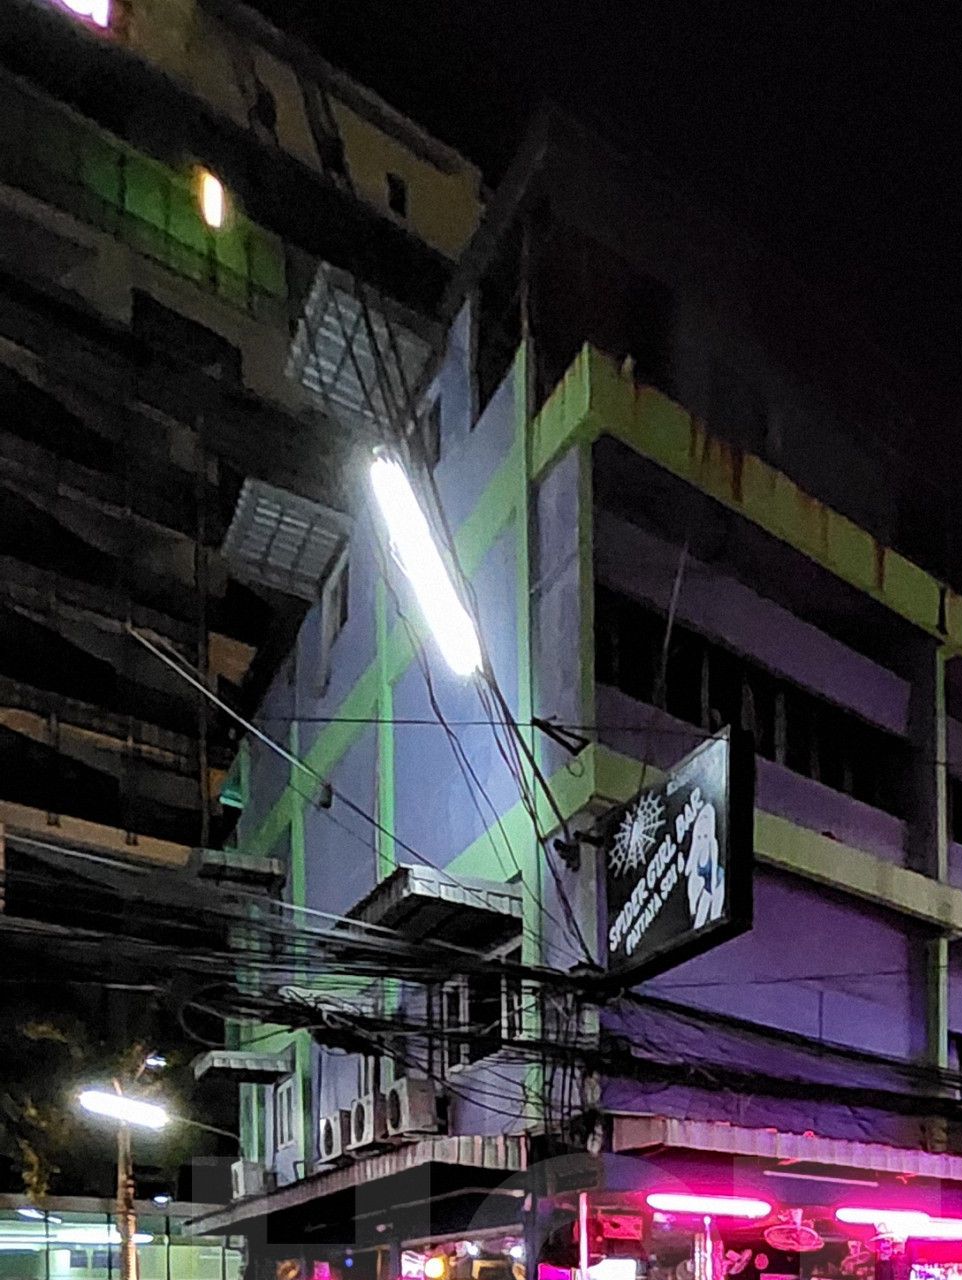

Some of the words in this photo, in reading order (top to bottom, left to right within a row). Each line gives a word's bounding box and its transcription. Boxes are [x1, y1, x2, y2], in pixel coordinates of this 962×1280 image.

[609, 878, 648, 951] SPIDER
[647, 834, 676, 888] GIRL
[676, 786, 704, 843] BAR
[626, 892, 662, 955] PATTAYA
